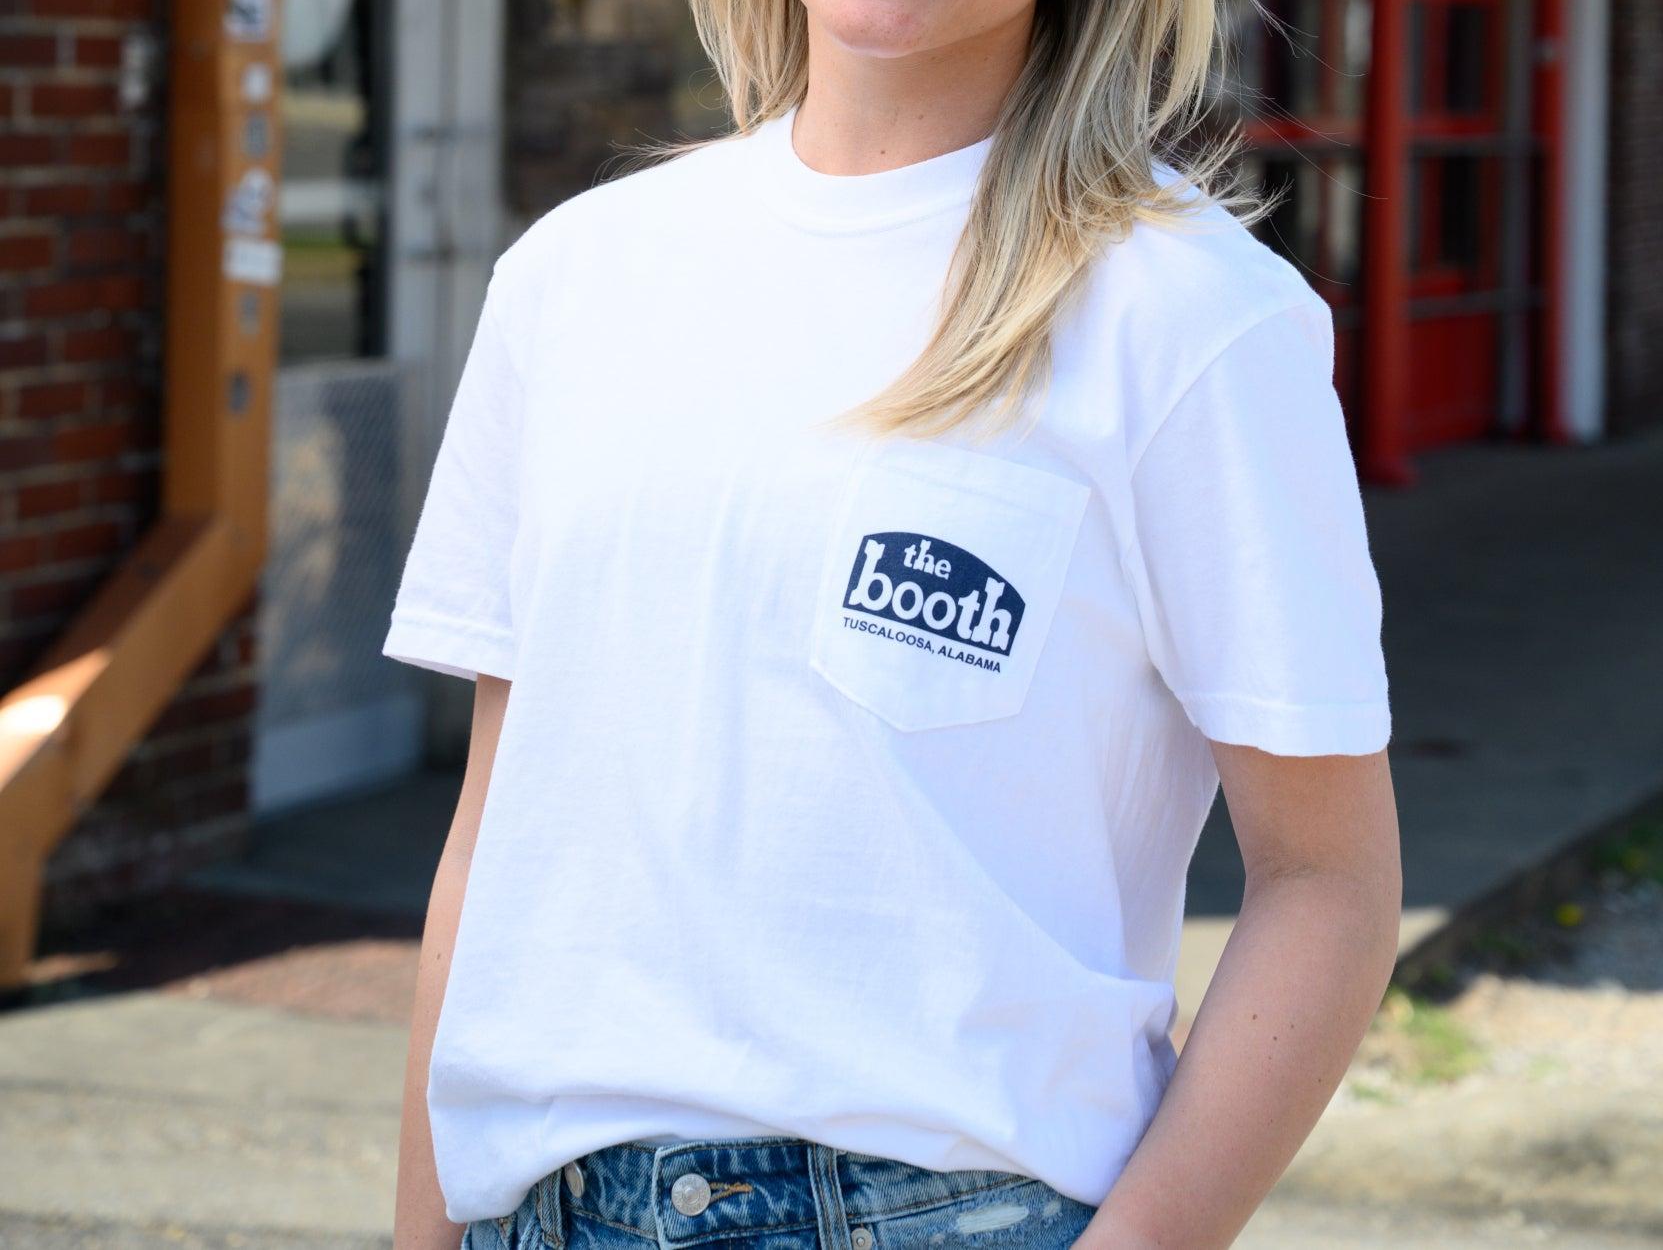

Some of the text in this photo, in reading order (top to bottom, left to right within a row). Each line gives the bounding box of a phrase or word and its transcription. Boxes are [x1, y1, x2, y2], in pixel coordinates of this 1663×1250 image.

[903, 539, 952, 580] the
[848, 539, 1013, 651] booth
[843, 616, 1001, 674] TUSCALOOSA, ALABAMA
